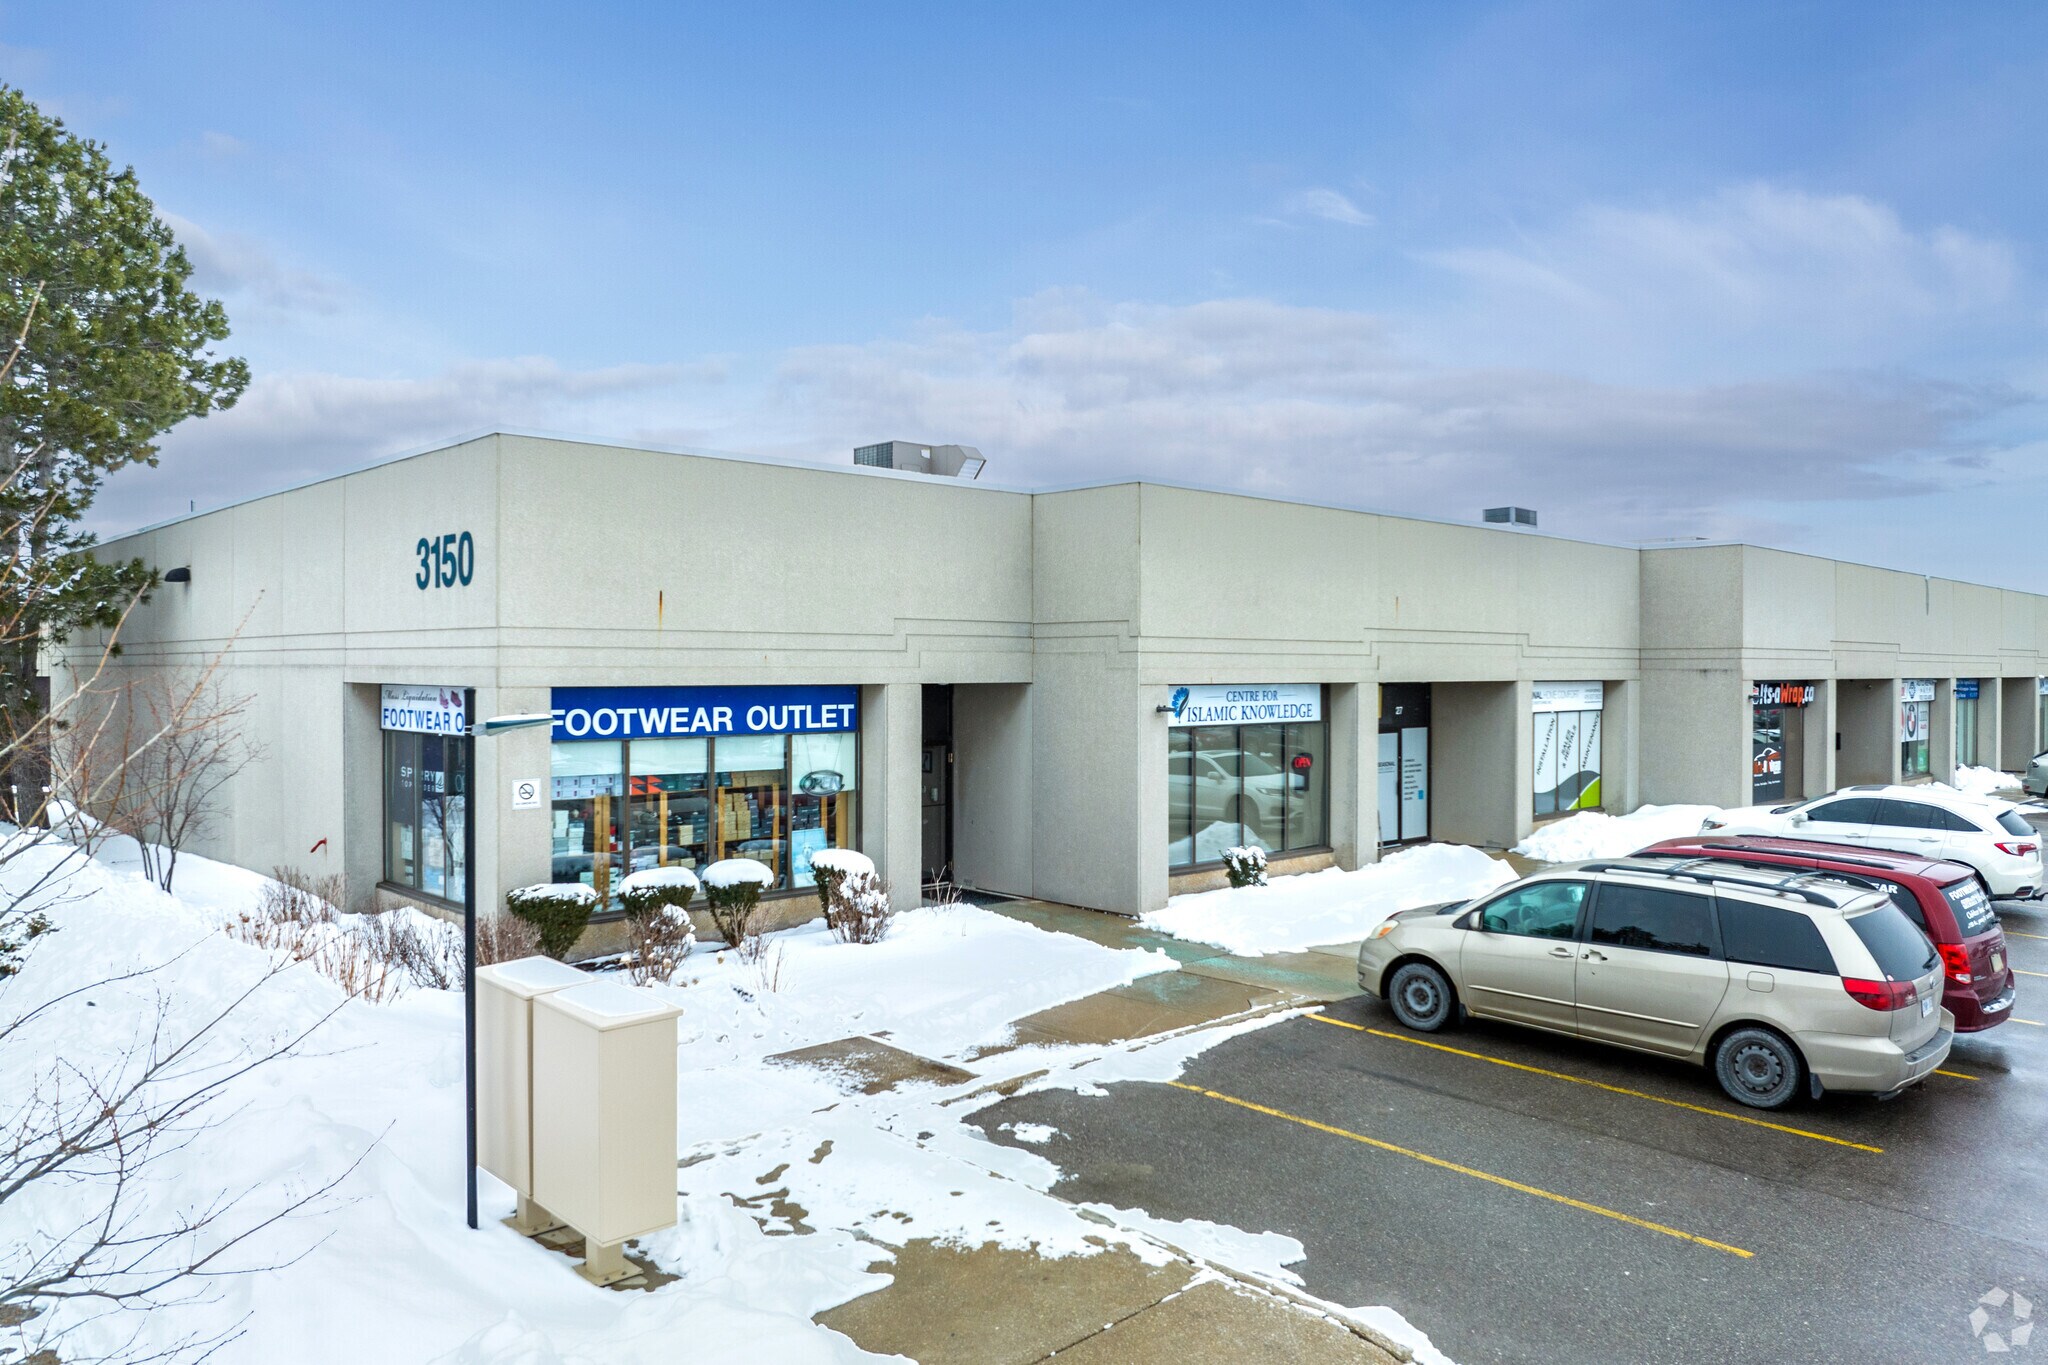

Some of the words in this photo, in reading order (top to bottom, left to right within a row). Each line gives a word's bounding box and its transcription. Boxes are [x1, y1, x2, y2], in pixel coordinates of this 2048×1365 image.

[416, 531, 474, 590] 3150
[402, 690, 437, 707] Liquidation
[1226, 690, 1259, 702] CENTRE
[1263, 690, 1278, 701] FOR
[383, 708, 450, 731] FOOTWEAR
[550, 706, 733, 736] FOOTWEAR
[746, 704, 854, 731] OUTLET
[1187, 706, 1237, 722] ISLAMIC
[1241, 703, 1313, 720] KNOWLEDGE
[1537, 718, 1555, 775] INSTALLATION
[1582, 712, 1600, 769] MAINTENANCE
[1294, 757, 1311, 768] OPEN
[401, 766, 435, 781] SPRY
